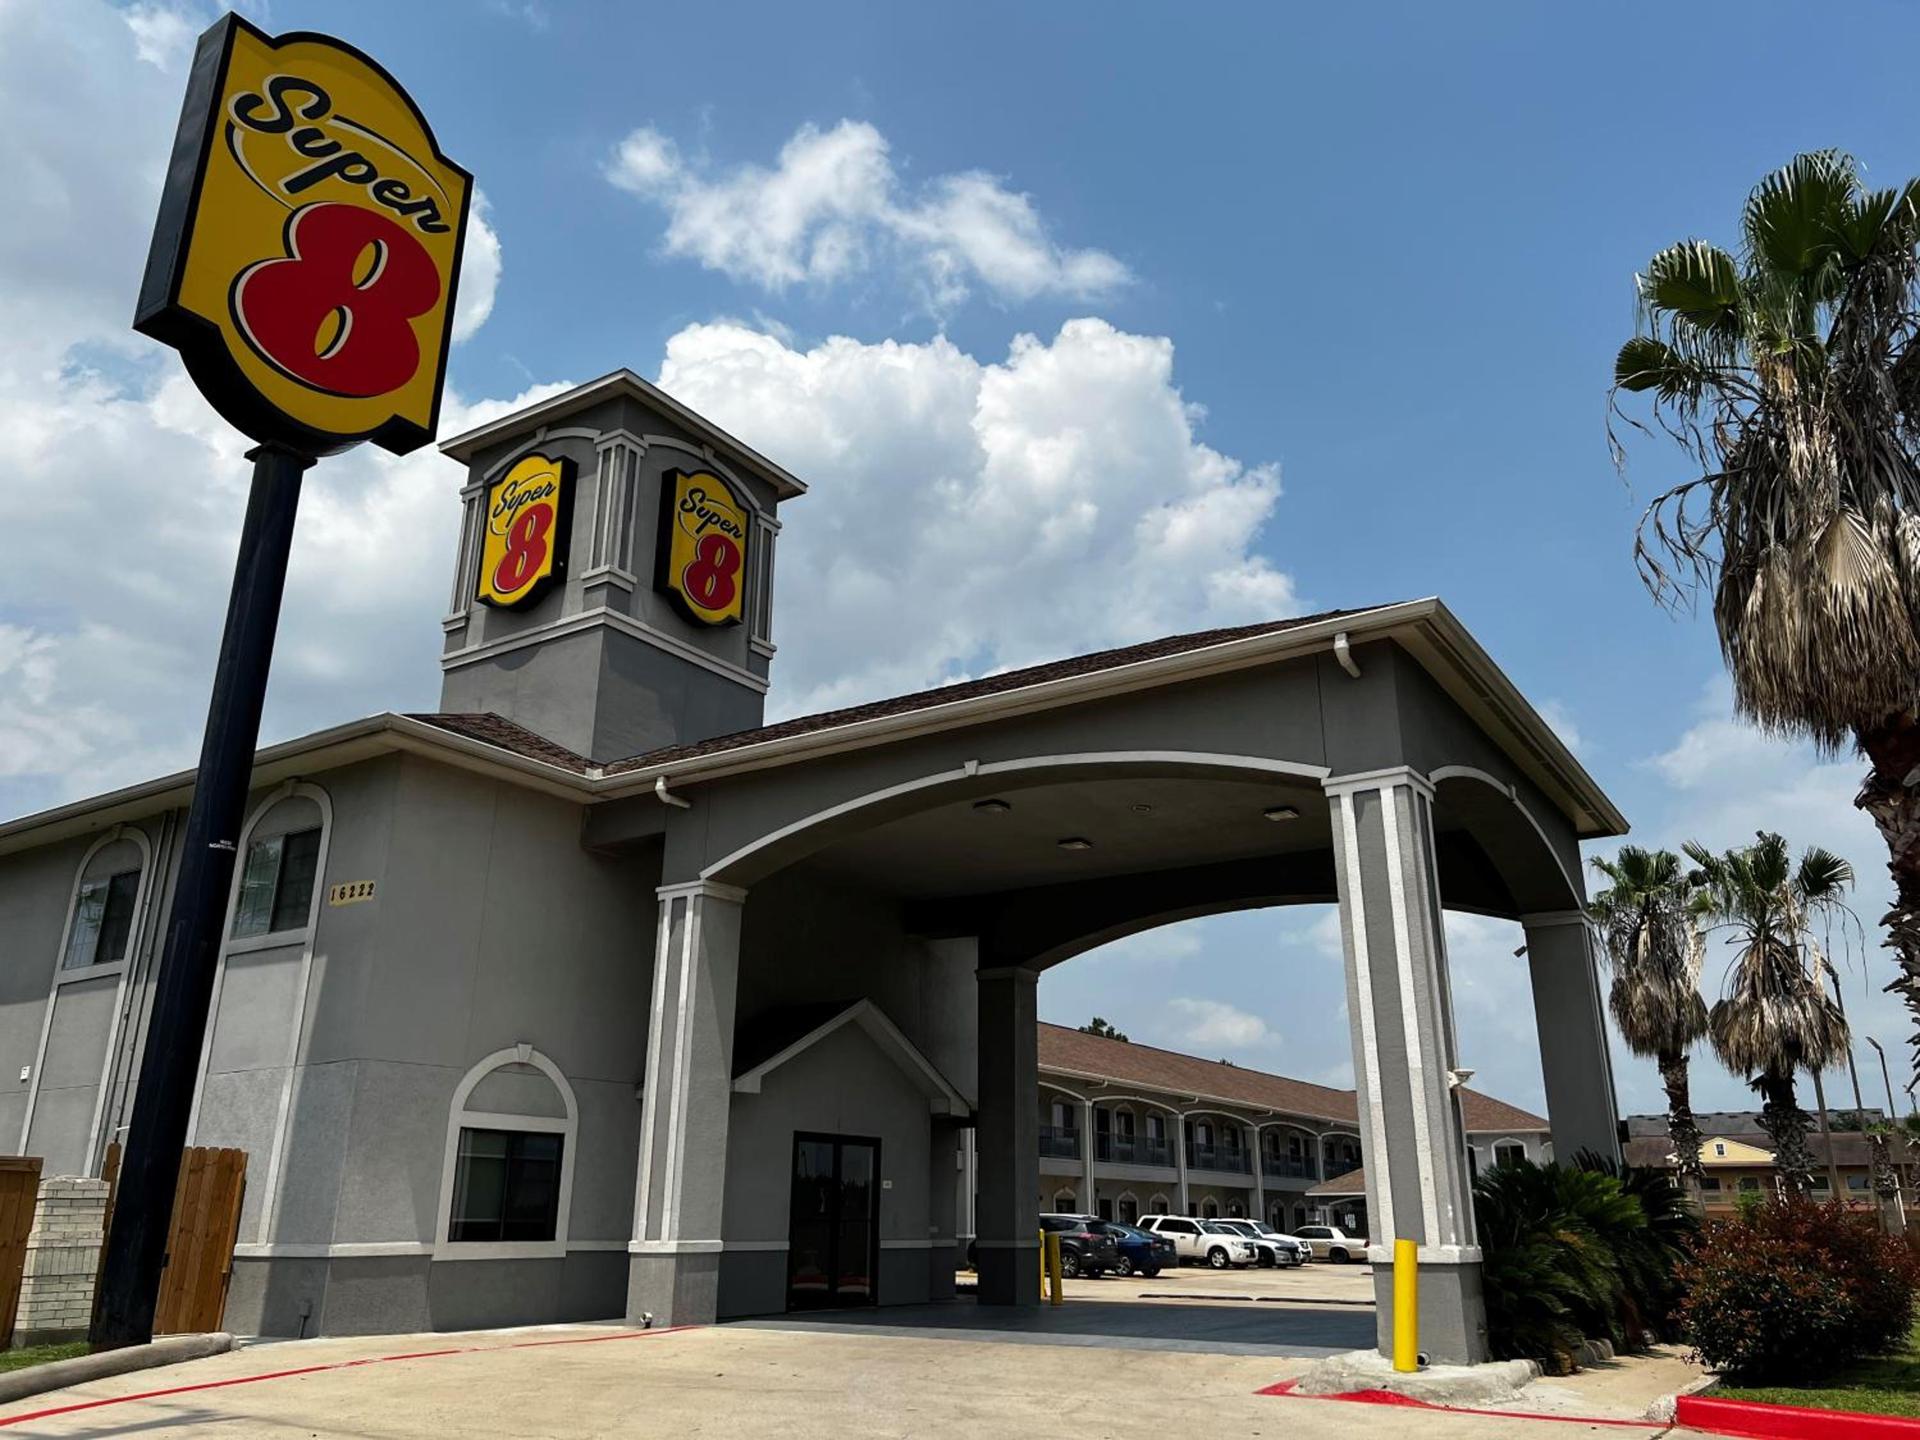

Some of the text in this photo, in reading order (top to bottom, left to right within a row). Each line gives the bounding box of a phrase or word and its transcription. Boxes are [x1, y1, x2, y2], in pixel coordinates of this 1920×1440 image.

[228, 73, 451, 234] Super
[228, 200, 441, 398] 8
[492, 479, 557, 528] Super
[680, 487, 743, 539] Super
[493, 502, 554, 593] 8
[681, 533, 741, 611] 8
[330, 880, 375, 902] 16222
